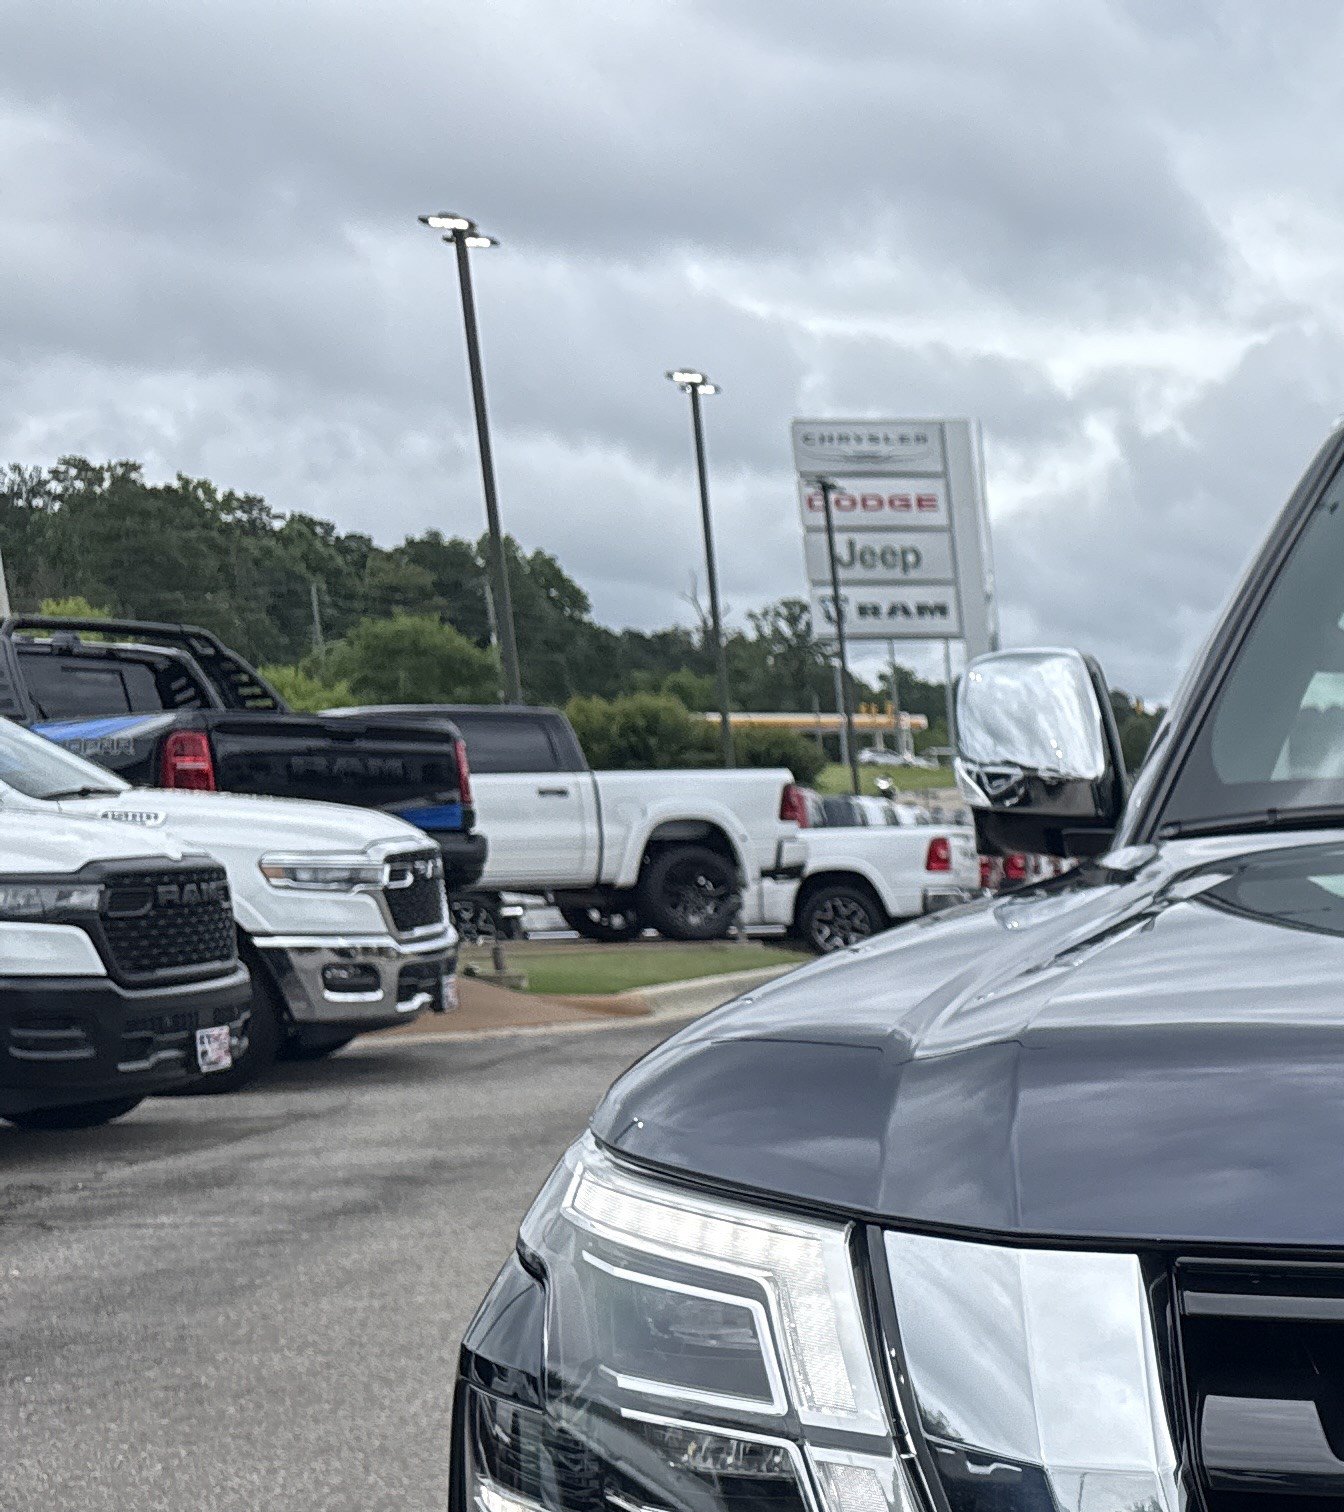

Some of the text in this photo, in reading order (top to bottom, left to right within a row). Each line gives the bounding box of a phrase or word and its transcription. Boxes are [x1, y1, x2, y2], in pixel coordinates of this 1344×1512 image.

[806, 491, 939, 512] DODGE
[833, 537, 922, 575] Jeep
[857, 602, 948, 618] RAM
